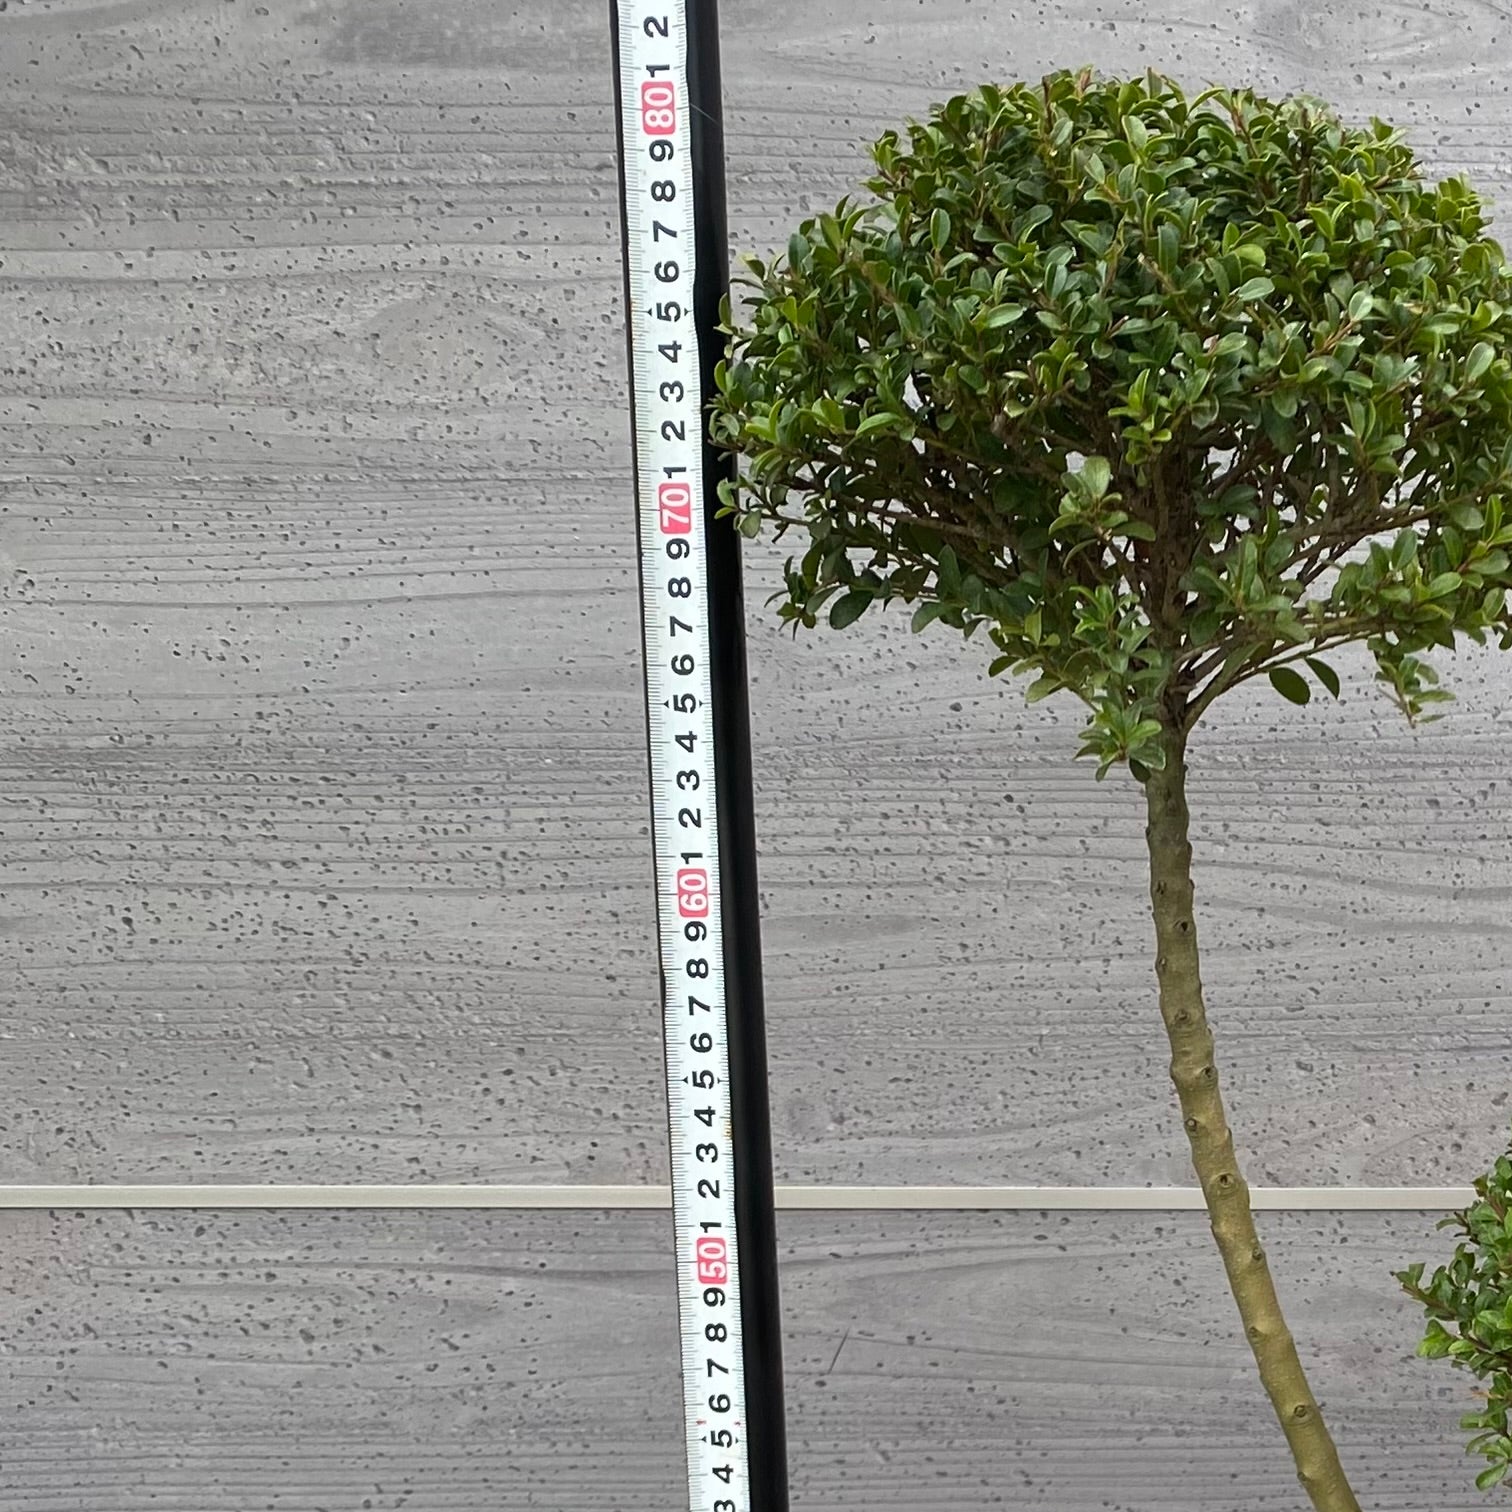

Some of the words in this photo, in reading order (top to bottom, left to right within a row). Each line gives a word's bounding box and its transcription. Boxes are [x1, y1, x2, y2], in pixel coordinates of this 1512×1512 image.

[643, 16, 669, 38] 2
[645, 64, 670, 78] 1
[643, 86, 675, 129] 80
[648, 139, 674, 162] 9
[650, 180, 676, 202] 8
[652, 220, 678, 243] 7
[654, 260, 680, 283] 6
[656, 301, 681, 323] 5
[658, 340, 682, 363] 4
[659, 381, 684, 403] 3
[661, 420, 686, 442] 2
[663, 466, 687, 479] 1
[659, 488, 691, 528] 70
[665, 538, 690, 560] 9
[667, 576, 692, 599] 8
[669, 615, 693, 637] 7
[670, 654, 695, 676] 6
[673, 693, 697, 714] 5
[674, 730, 698, 753] 4
[676, 769, 700, 791] 3
[678, 807, 702, 828] 2
[680, 852, 703, 865] 1
[678, 872, 708, 912] 60
[684, 920, 707, 942] 9
[686, 958, 709, 979] 8
[687, 995, 711, 1016] 7
[689, 1032, 713, 1054] 6
[691, 1070, 715, 1090] 5
[693, 1105, 716, 1127] 4
[695, 1143, 719, 1163] 3
[697, 1179, 720, 1199] 2
[699, 1221, 722, 1234] 1
[696, 1242, 727, 1280] 50
[703, 1287, 726, 1307] 9
[704, 1323, 728, 1343] 8
[706, 1358, 729, 1378] 7
[708, 1394, 731, 1413] 6
[710, 1429, 733, 1449] 5
[712, 1464, 734, 1484] 4
